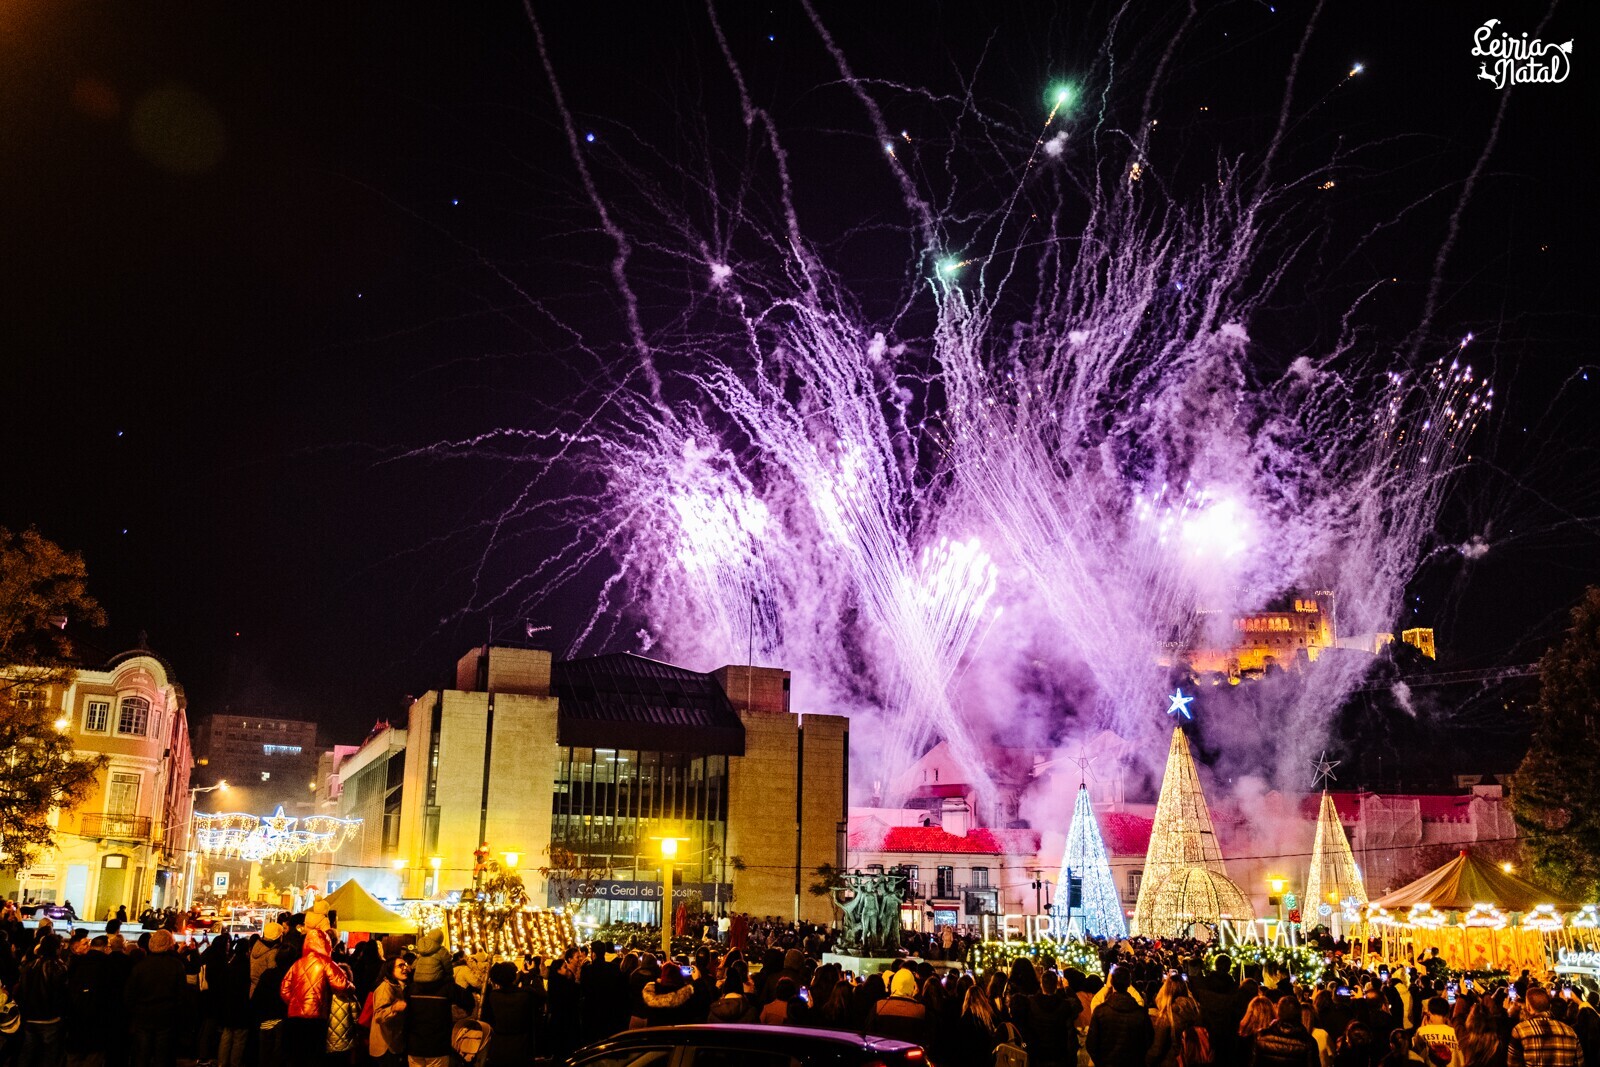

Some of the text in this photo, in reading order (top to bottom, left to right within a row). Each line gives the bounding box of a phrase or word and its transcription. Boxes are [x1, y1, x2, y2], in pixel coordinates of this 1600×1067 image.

[610, 884, 638, 897] Geral
[640, 885, 654, 897] de
[982, 914, 1085, 946] LEIRIA
[1220, 918, 1305, 949] NATAL
[1442, 1034, 1455, 1042] ALL
